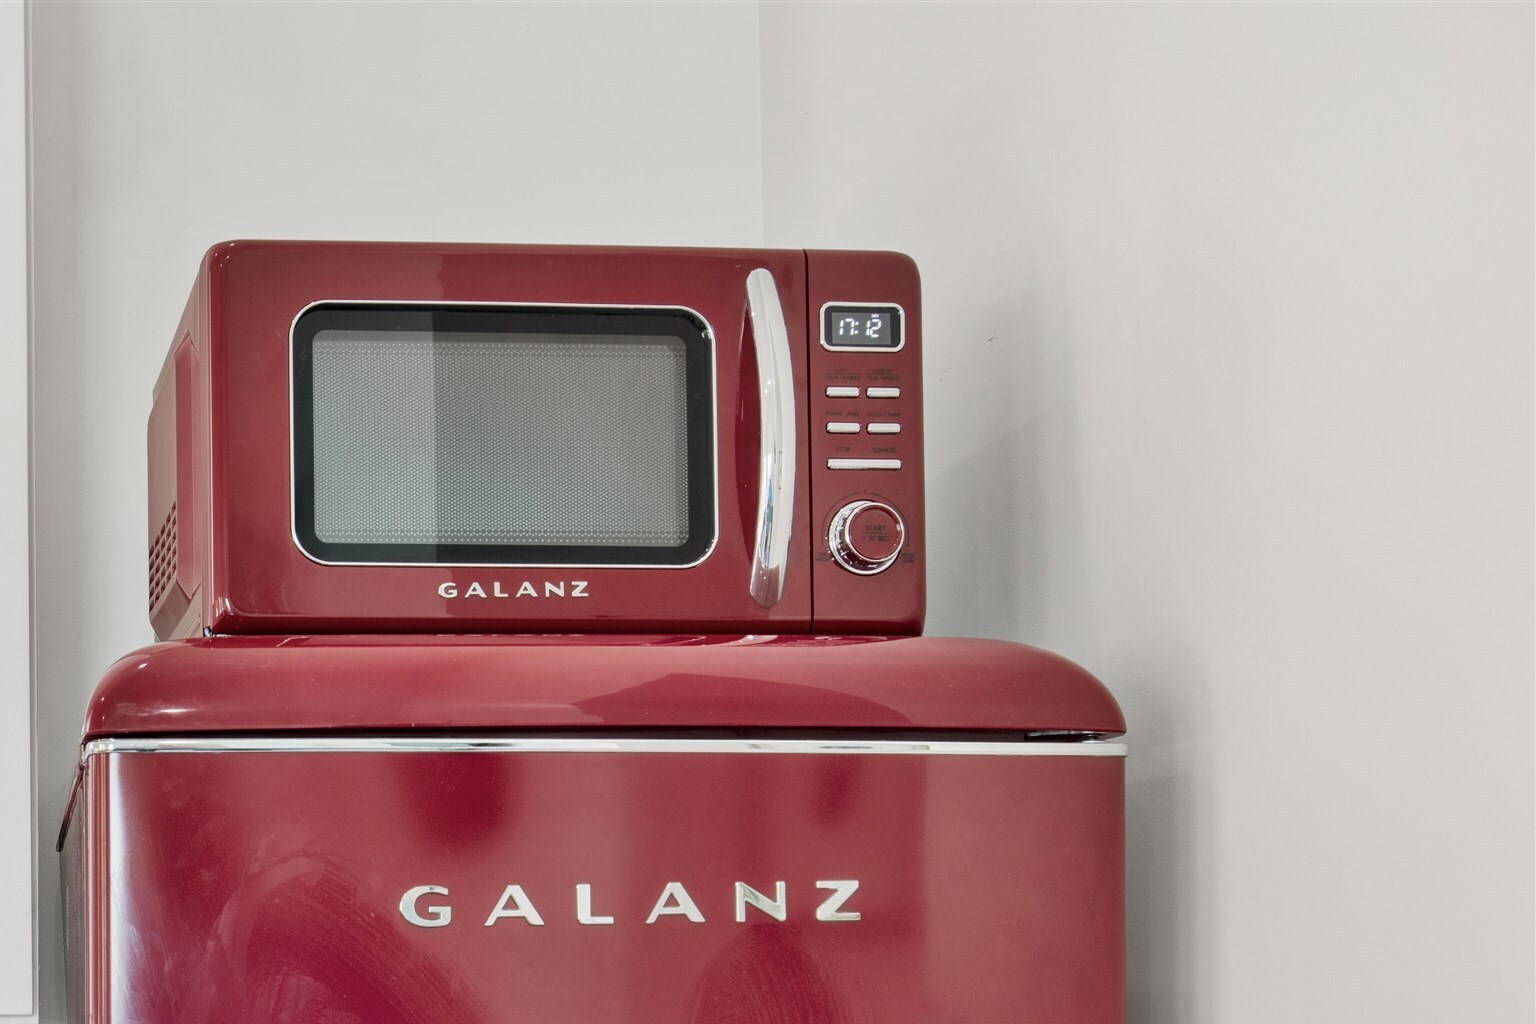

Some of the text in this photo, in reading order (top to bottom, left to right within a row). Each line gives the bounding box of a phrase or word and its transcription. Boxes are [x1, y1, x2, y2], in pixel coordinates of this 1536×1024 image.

[839, 318, 882, 338] 17:12
[438, 581, 589, 598] GALANZ
[399, 880, 861, 927] GALANZ
